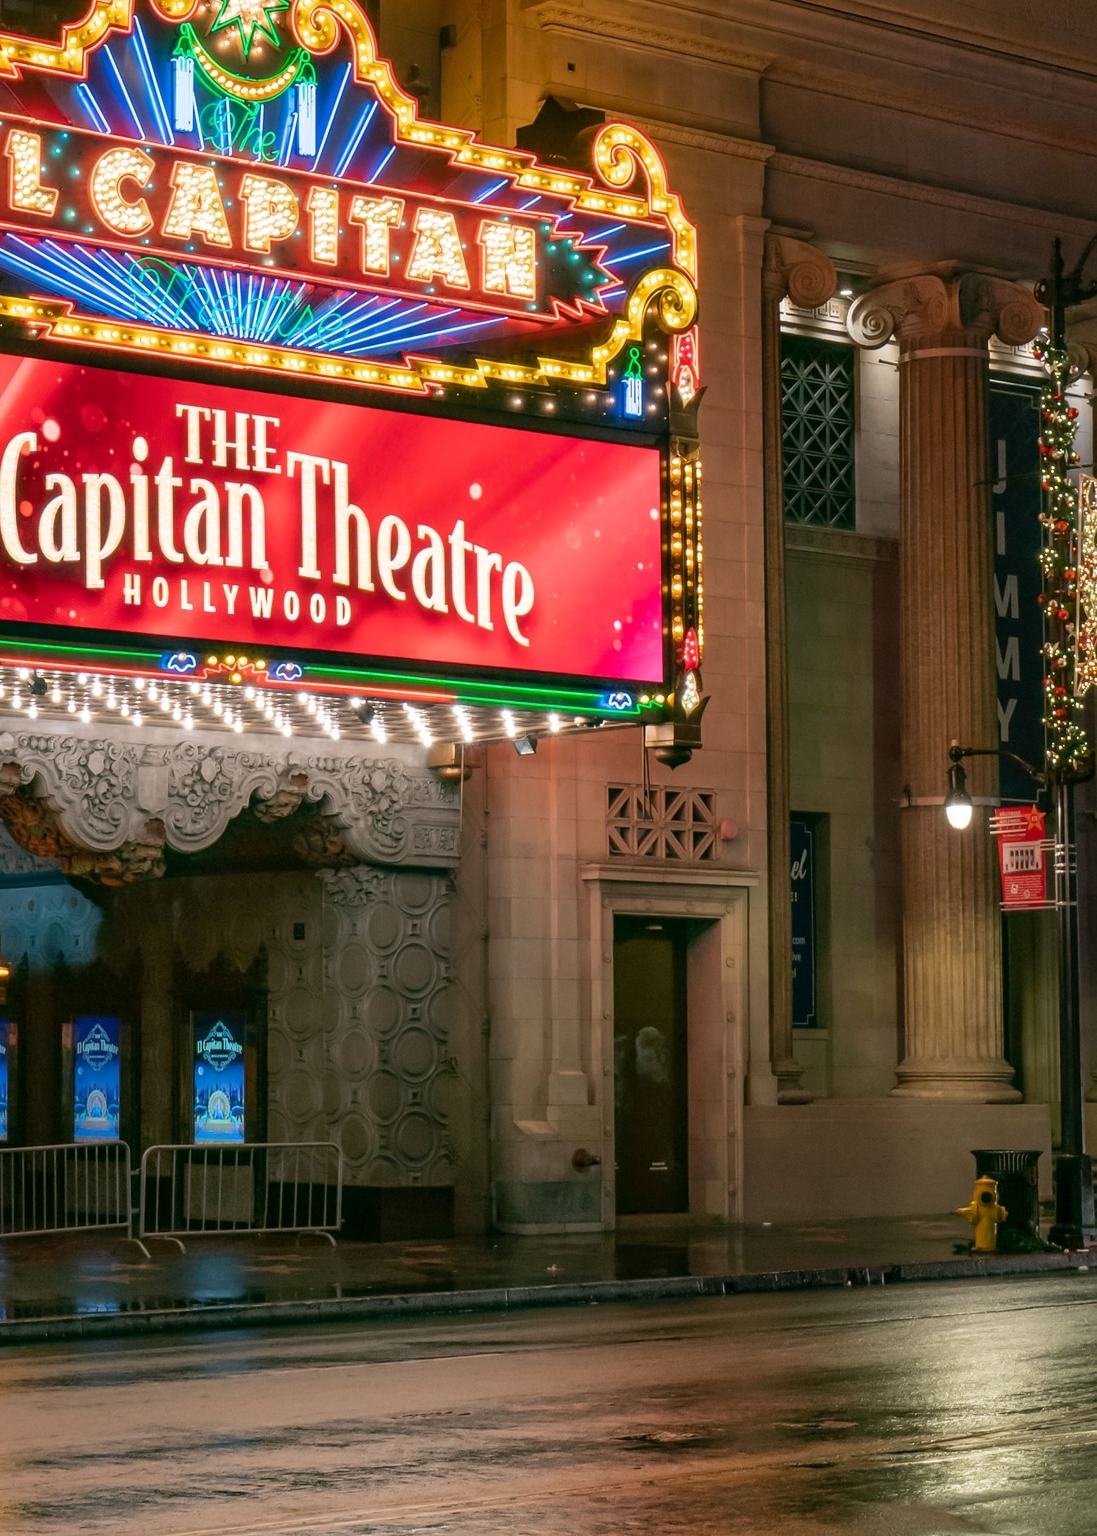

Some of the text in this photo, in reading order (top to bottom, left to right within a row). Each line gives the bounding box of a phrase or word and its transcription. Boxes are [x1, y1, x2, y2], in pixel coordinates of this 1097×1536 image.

[202, 97, 280, 162] The
[90, 145, 537, 300] CAPITAN
[128, 256, 351, 346] Theatre
[175, 403, 282, 475] THE
[286, 449, 535, 648] Theatre
[123, 573, 353, 627] HOLLYWOOD
